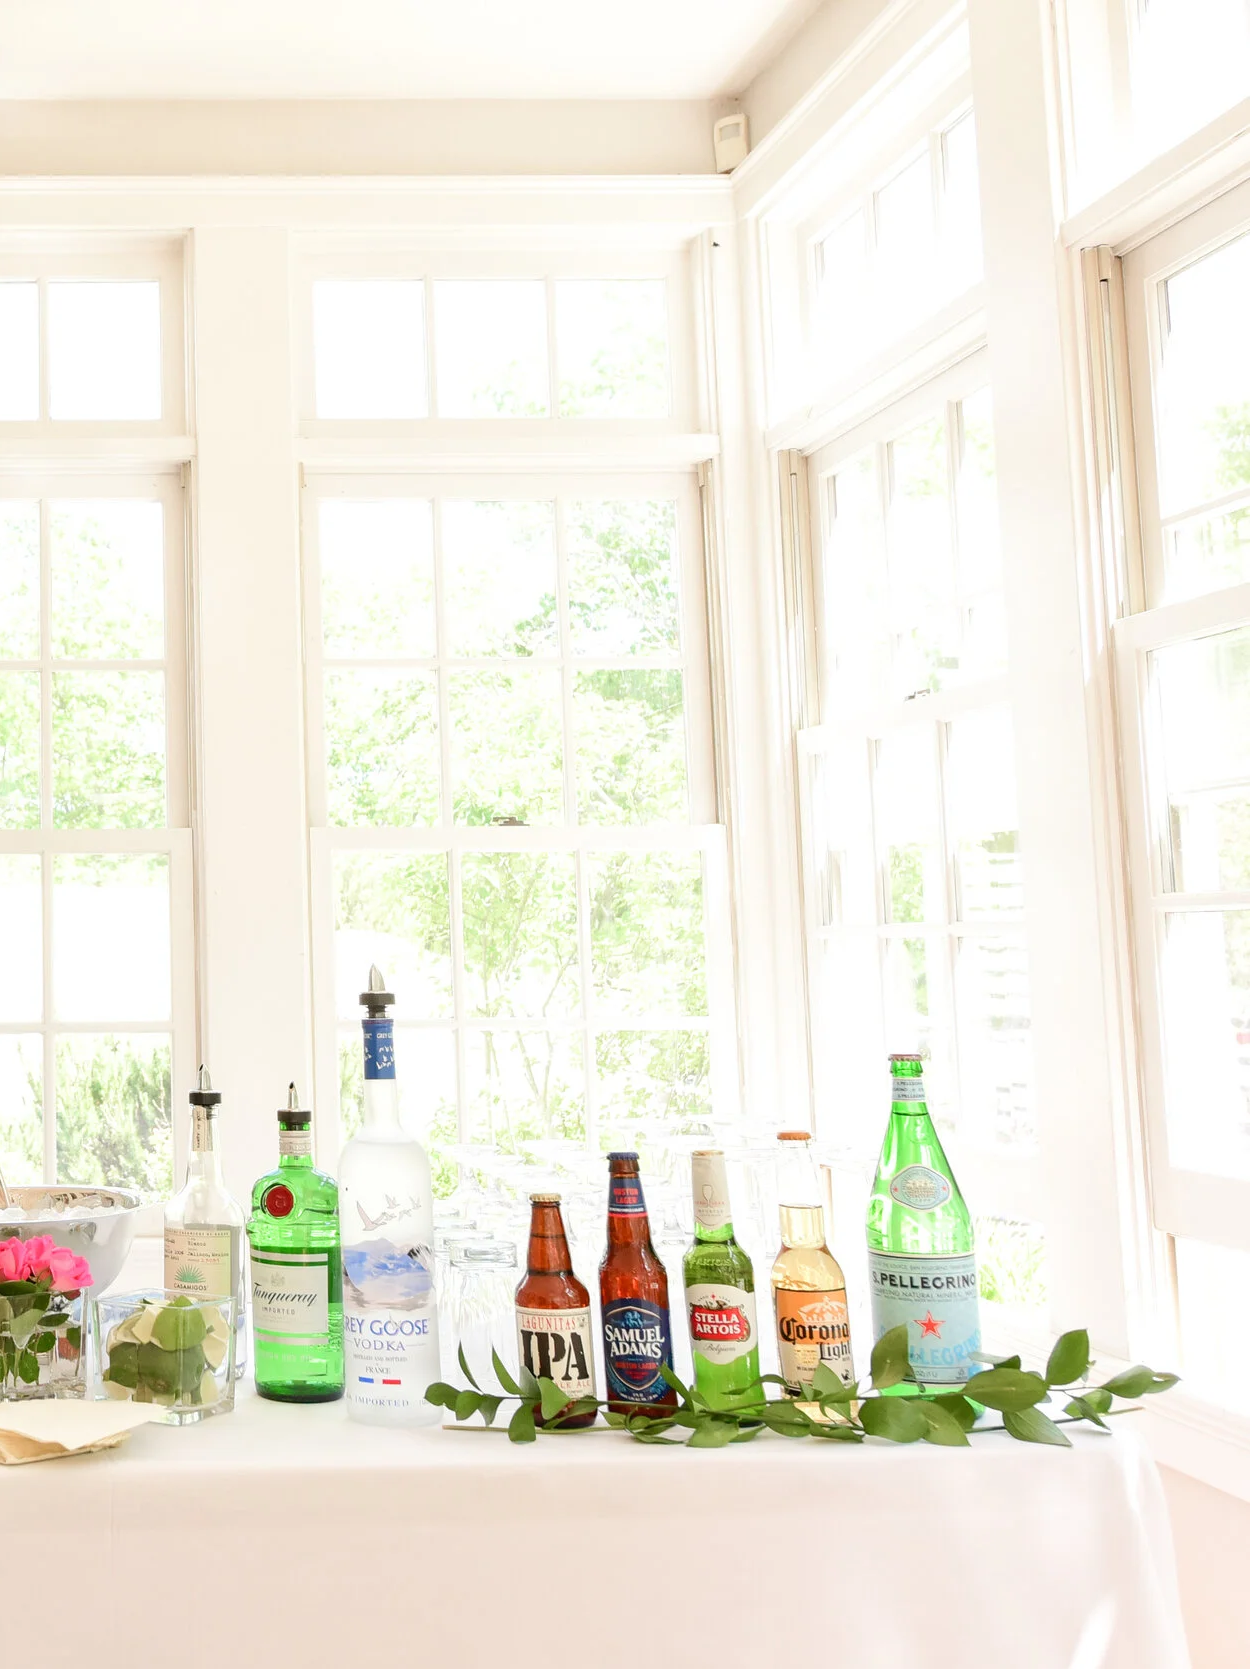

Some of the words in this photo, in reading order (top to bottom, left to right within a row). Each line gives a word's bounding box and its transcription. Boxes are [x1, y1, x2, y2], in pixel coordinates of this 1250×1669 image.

[174, 1282, 207, 1291] CASAMIGOS
[253, 1282, 318, 1306] Tanqueray
[262, 1306, 296, 1315] IMPORTED
[695, 1312, 739, 1324] STELLA
[346, 1315, 364, 1334] REY
[370, 1318, 430, 1336] GOOSE
[521, 1315, 576, 1331] LAGUNITAS
[696, 1323, 741, 1335] ARTOIS
[779, 1316, 849, 1345] Corona
[604, 1324, 665, 1343] SAMUEL
[354, 1337, 406, 1351] VODKA
[610, 1341, 662, 1359] ADAMS
[520, 1330, 589, 1381] IPA
[365, 1365, 391, 1375] FRANCE
[355, 1396, 409, 1408] IMPORTED
